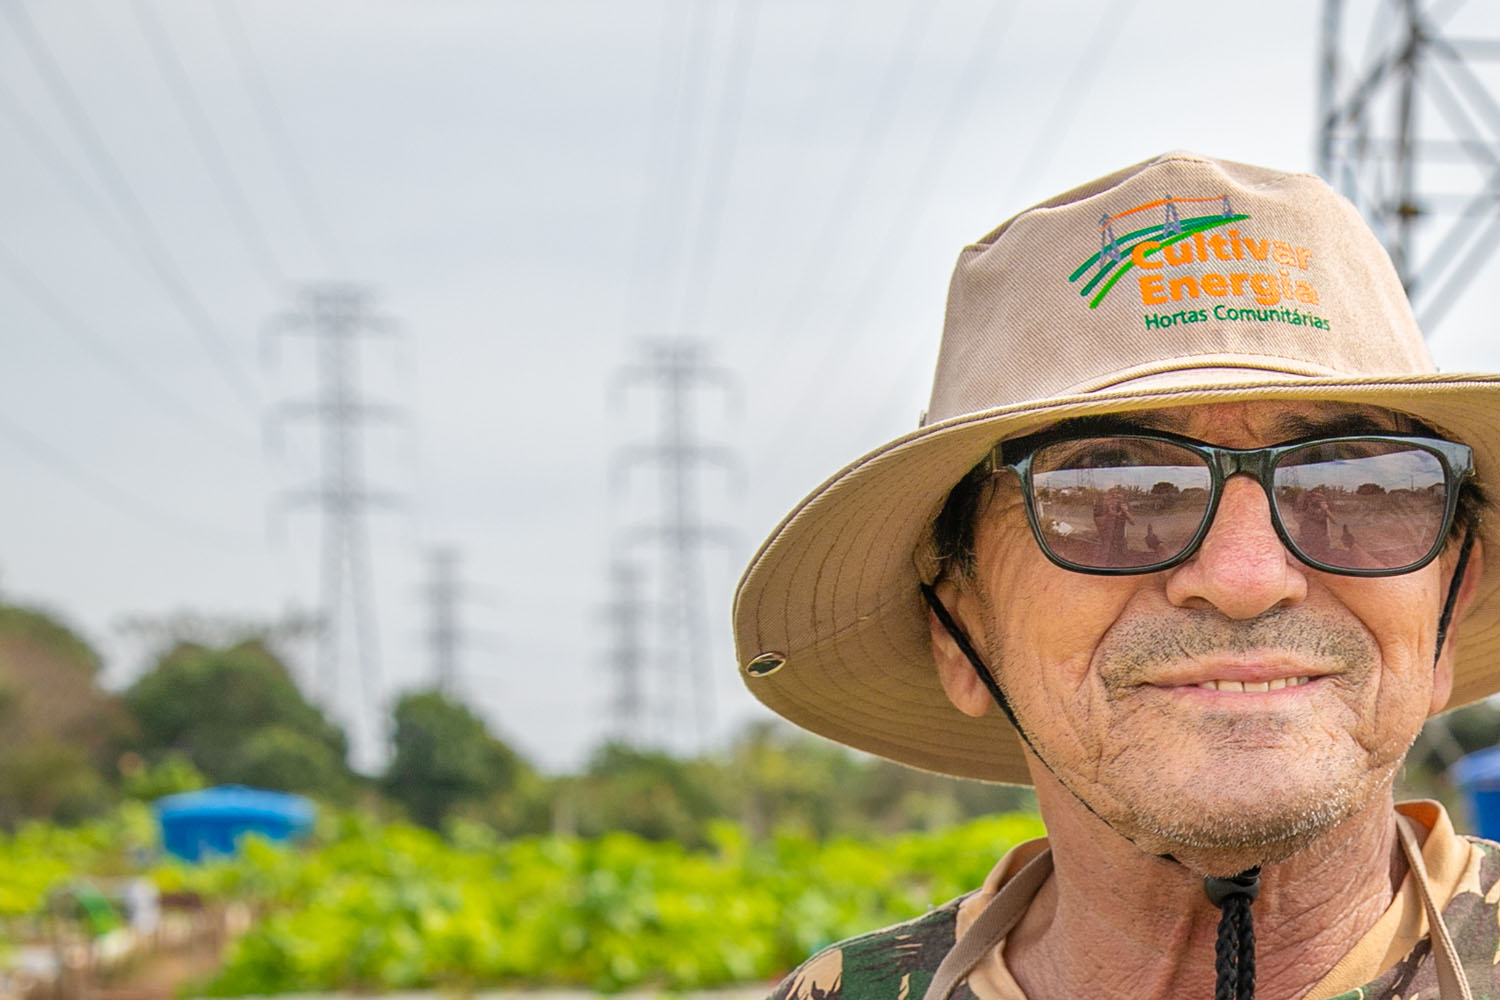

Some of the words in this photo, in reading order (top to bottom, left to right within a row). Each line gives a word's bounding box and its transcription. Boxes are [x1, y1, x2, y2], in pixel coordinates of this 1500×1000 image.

[1131, 229, 1312, 271] Cultivar
[1137, 267, 1320, 306] Energia
[1144, 307, 1208, 331] Hortas
[1213, 304, 1330, 331] Comunitárias
